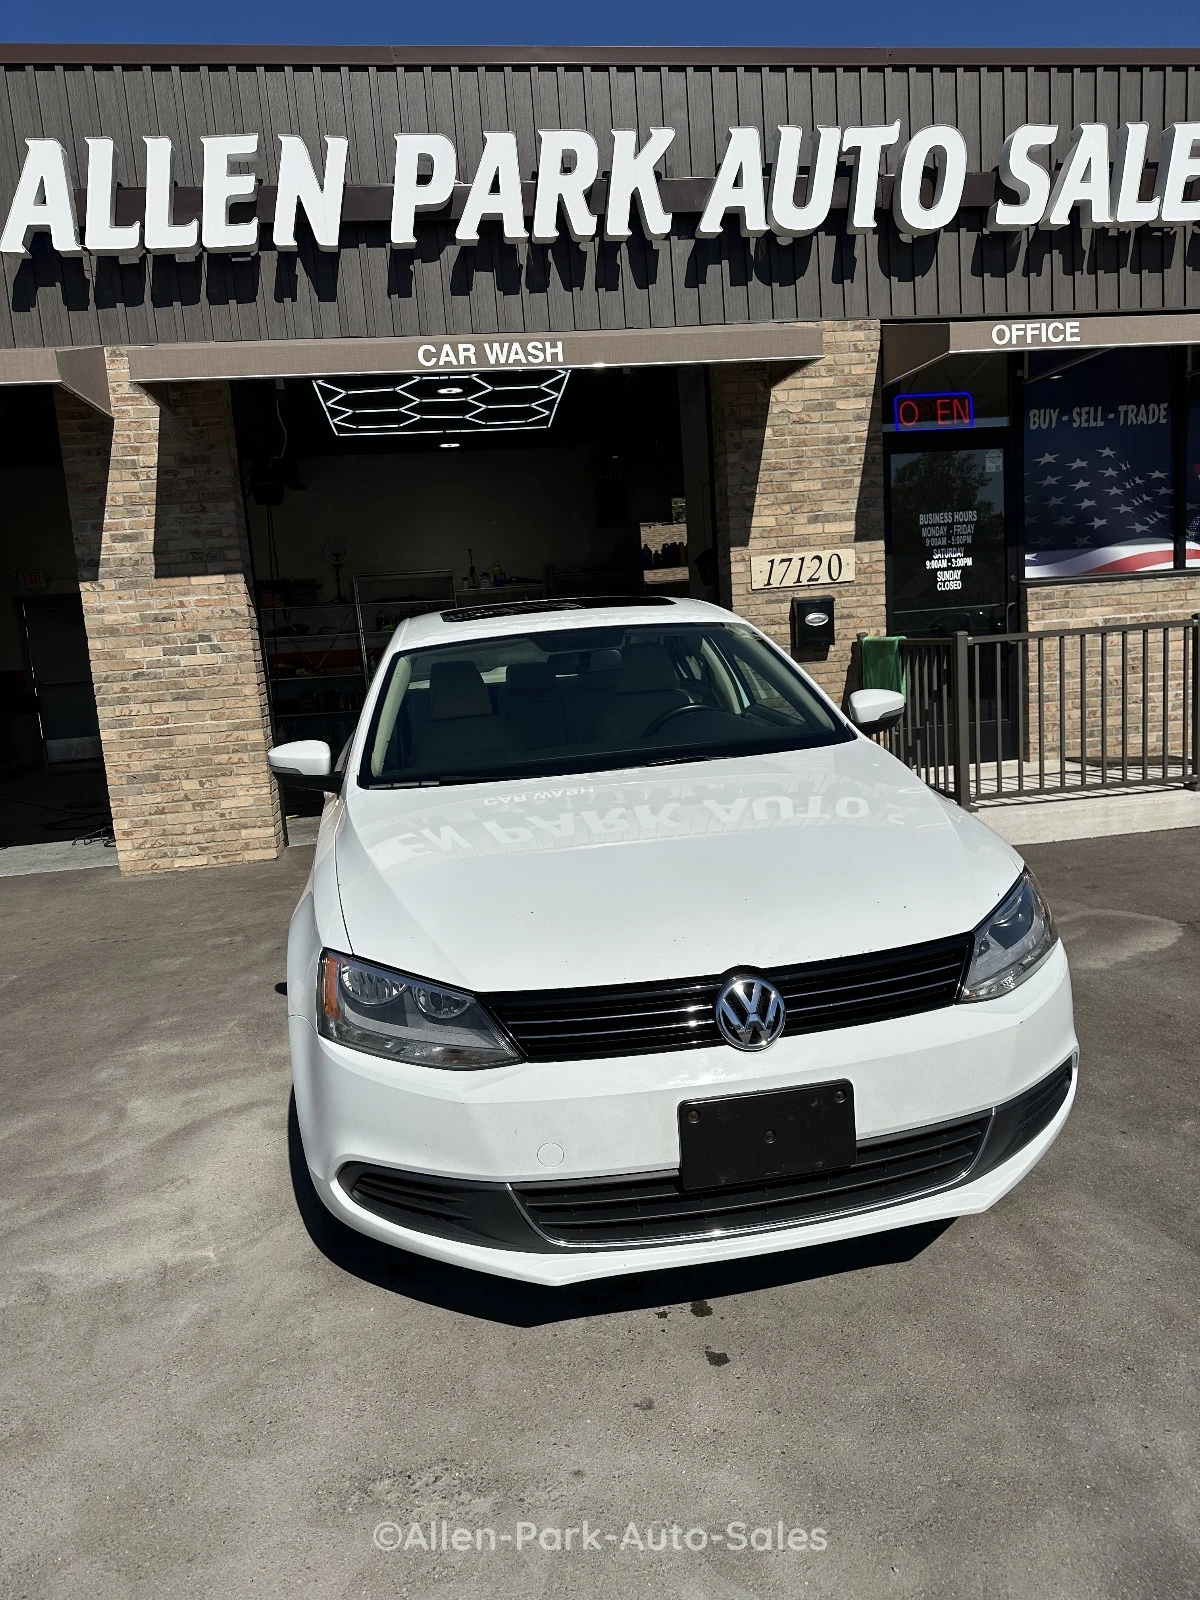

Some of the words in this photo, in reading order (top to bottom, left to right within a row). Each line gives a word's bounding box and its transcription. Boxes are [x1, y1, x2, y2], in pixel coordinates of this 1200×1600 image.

[0, 132, 349, 255] ALLEN
[391, 127, 675, 246] PARK
[698, 119, 968, 236] AUTO
[991, 321, 1081, 345] OFFICE
[417, 344, 476, 367] CAR
[484, 340, 564, 365] WASH
[1029, 408, 1059, 429] BUY
[1072, 406, 1104, 428] SELL
[1118, 403, 1168, 426] TRADE
[920, 512, 953, 525] BUSINESS
[953, 510, 978, 523] HOURS
[921, 526, 948, 537] MONDAY
[953, 524, 975, 535] FRIDAY
[933, 547, 965, 559] SATURDAY
[763, 553, 843, 587] 17120
[936, 569, 962, 581] SUNDAY
[936, 580, 962, 591] CLOSED
